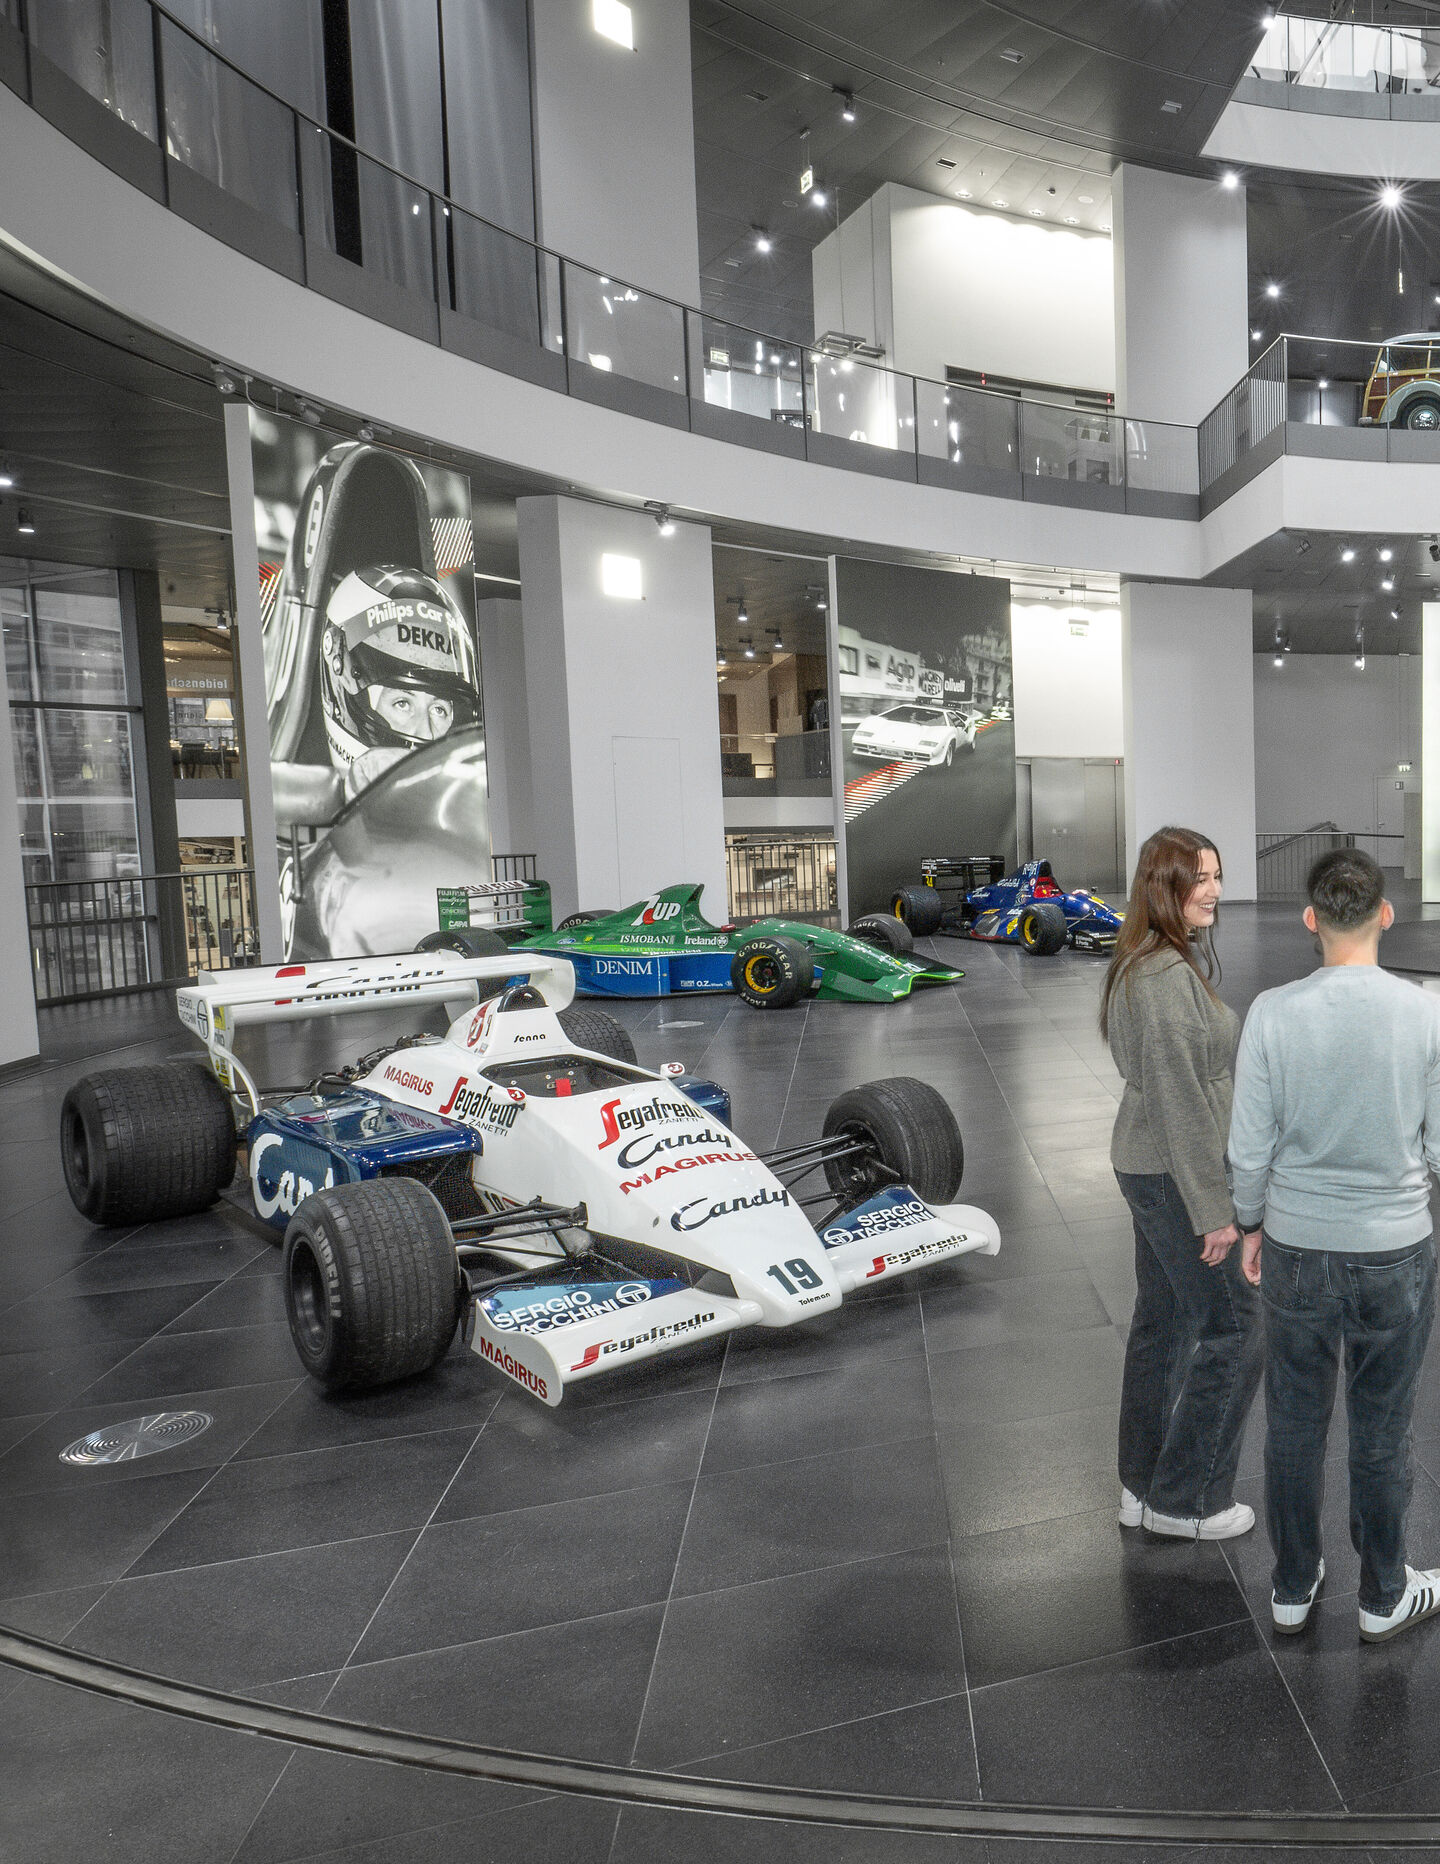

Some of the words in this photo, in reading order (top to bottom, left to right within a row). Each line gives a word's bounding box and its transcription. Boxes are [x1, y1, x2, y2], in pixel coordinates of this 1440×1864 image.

[366, 602, 415, 628] Philips
[416, 602, 443, 623] Car
[630, 894, 682, 927] 7UP
[684, 935, 717, 946] Ireland
[596, 960, 653, 975] DENIM
[383, 1064, 435, 1097] MAGIRUS
[468, 1117, 509, 1137] ZANETTI
[617, 1128, 732, 1170] Candy
[618, 1151, 760, 1196] MAGIRUS
[670, 1188, 790, 1232] Candy
[852, 1210, 934, 1241] TACCHINI
[857, 1201, 924, 1227] SERGIO
[313, 1223, 342, 1318] PIRELLI
[866, 1233, 968, 1279] Segafredo
[766, 1257, 824, 1296] 19
[492, 1290, 593, 1328] SERGIO
[798, 1292, 831, 1306] Toleman
[570, 1311, 716, 1373] Segafredo
[480, 1336, 548, 1400] MAGIRUS
